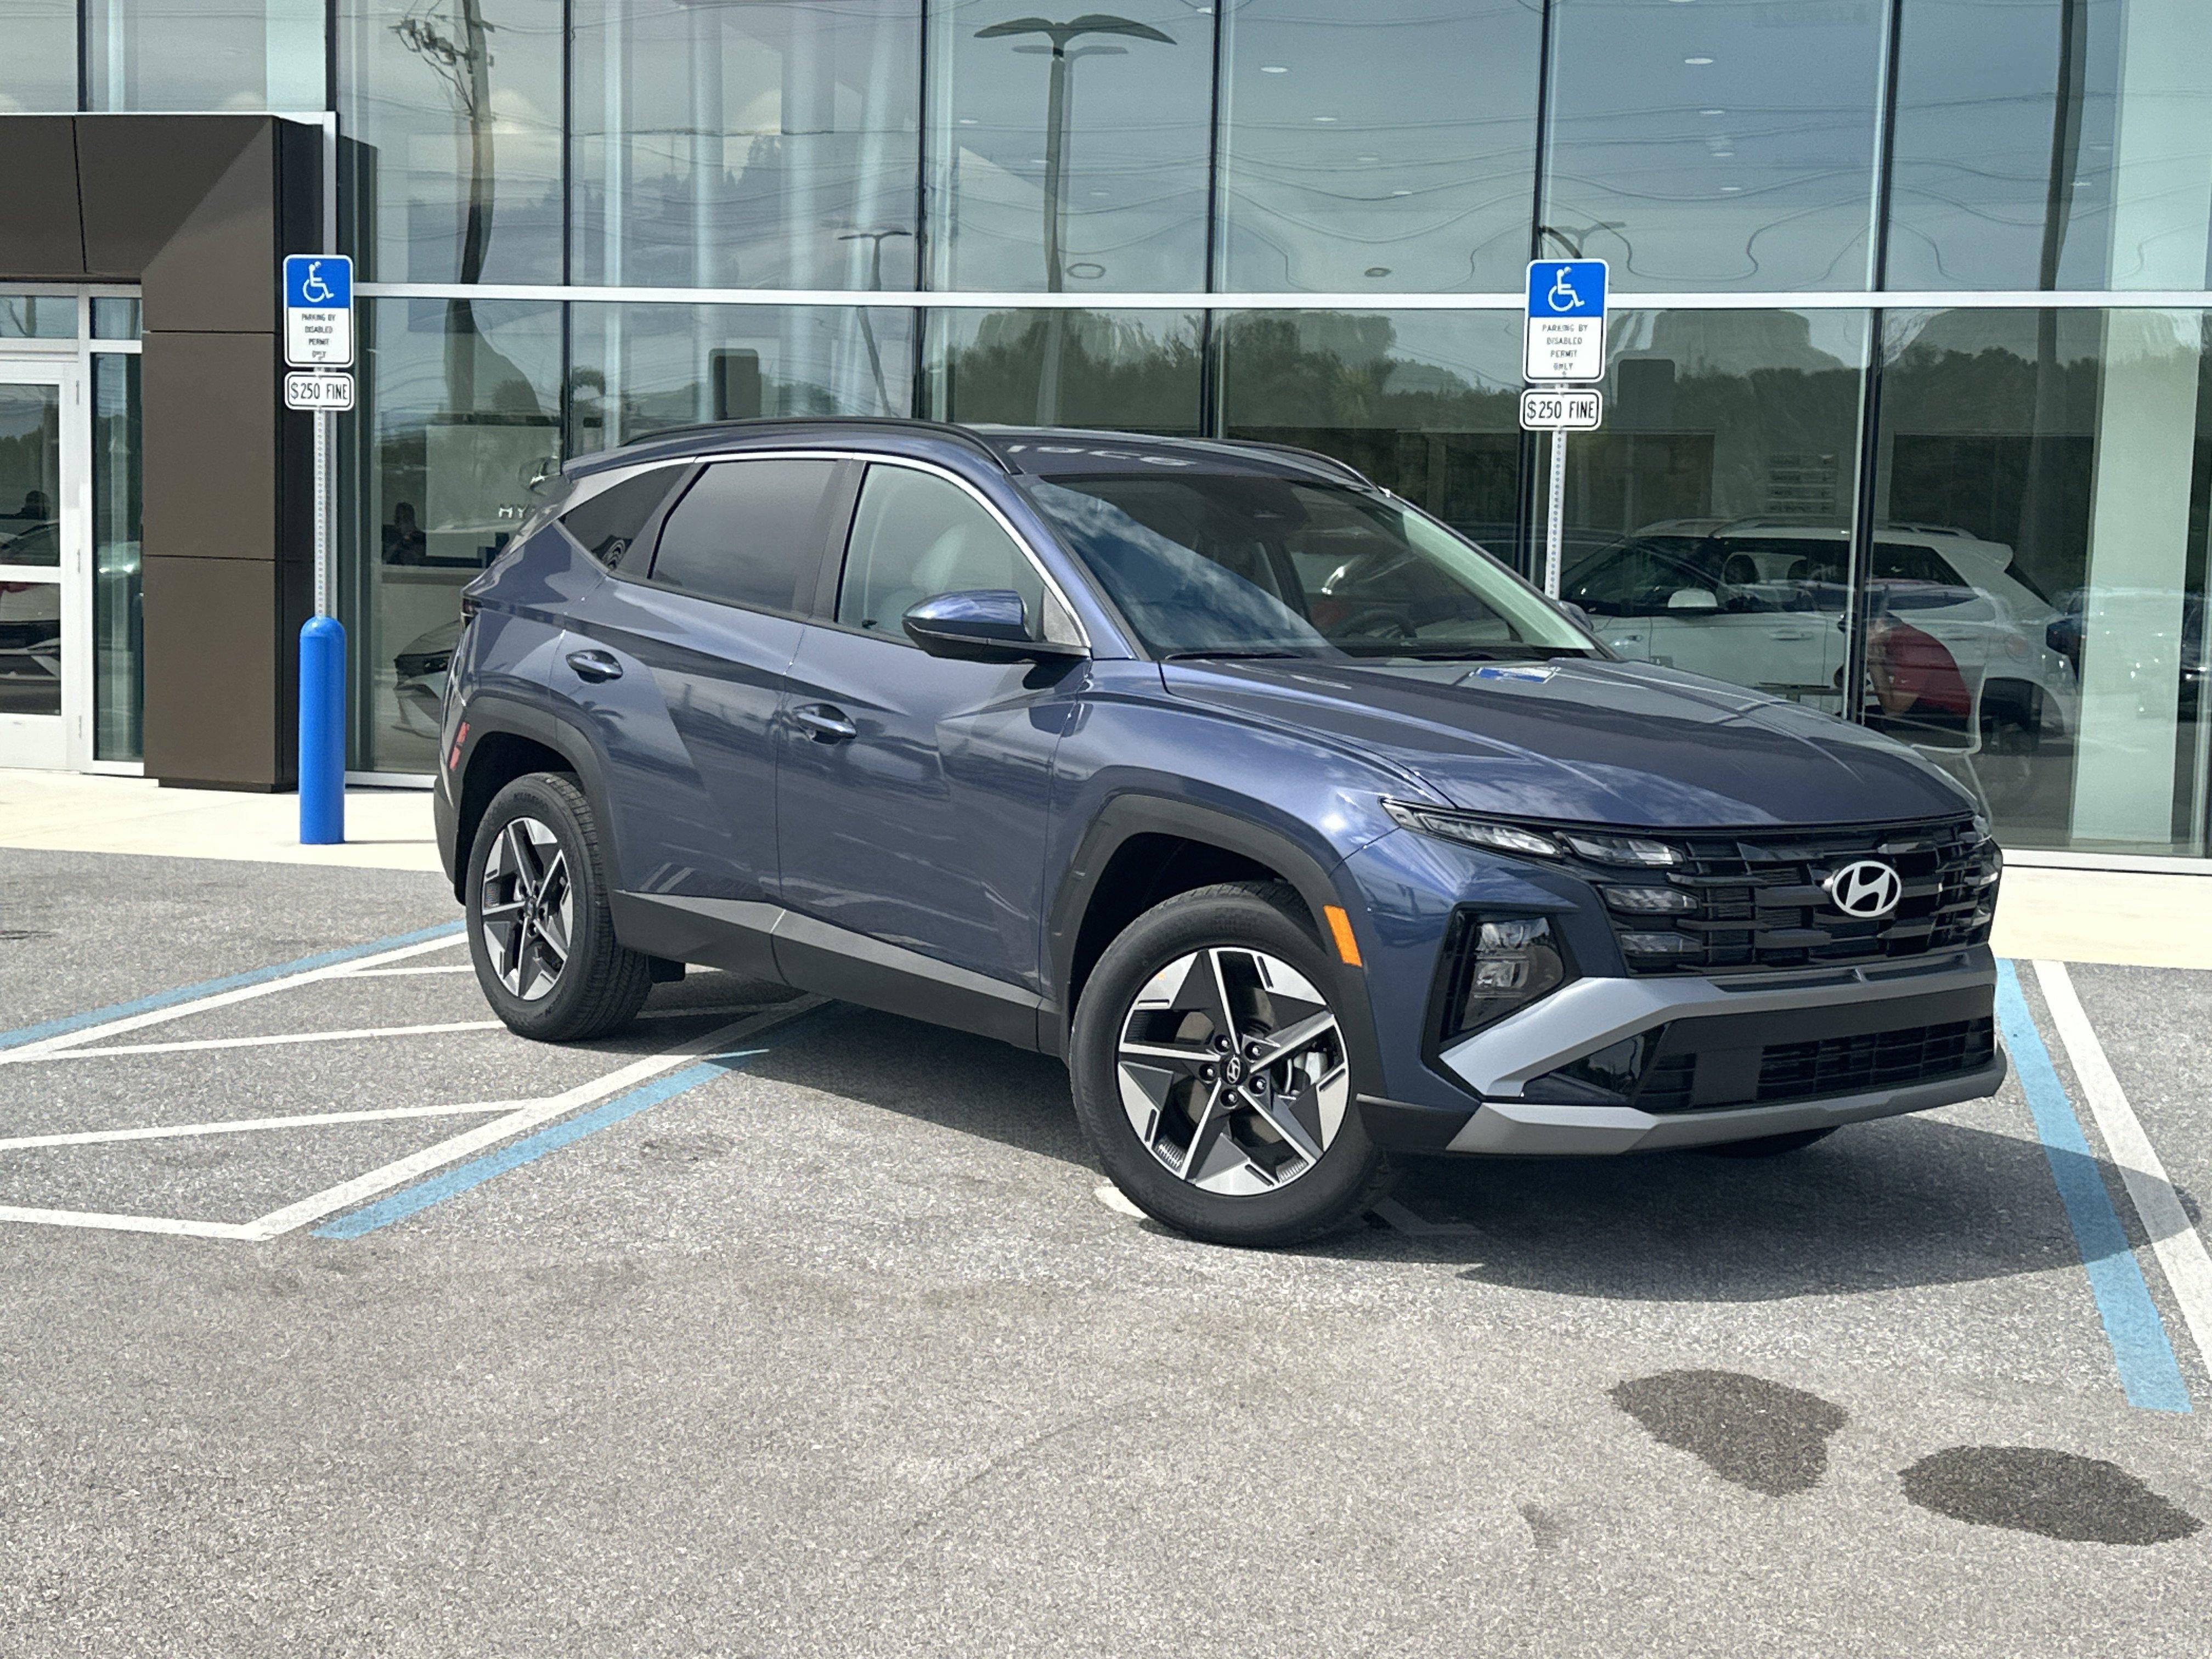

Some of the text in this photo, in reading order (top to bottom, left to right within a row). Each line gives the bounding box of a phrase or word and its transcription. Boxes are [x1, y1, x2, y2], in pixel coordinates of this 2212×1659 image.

[1578, 324, 1588, 332] BY
[1550, 349, 1577, 358] PERMIT
[290, 382, 348, 400] $250 FINE
[1527, 400, 1595, 420] $250 FINE
